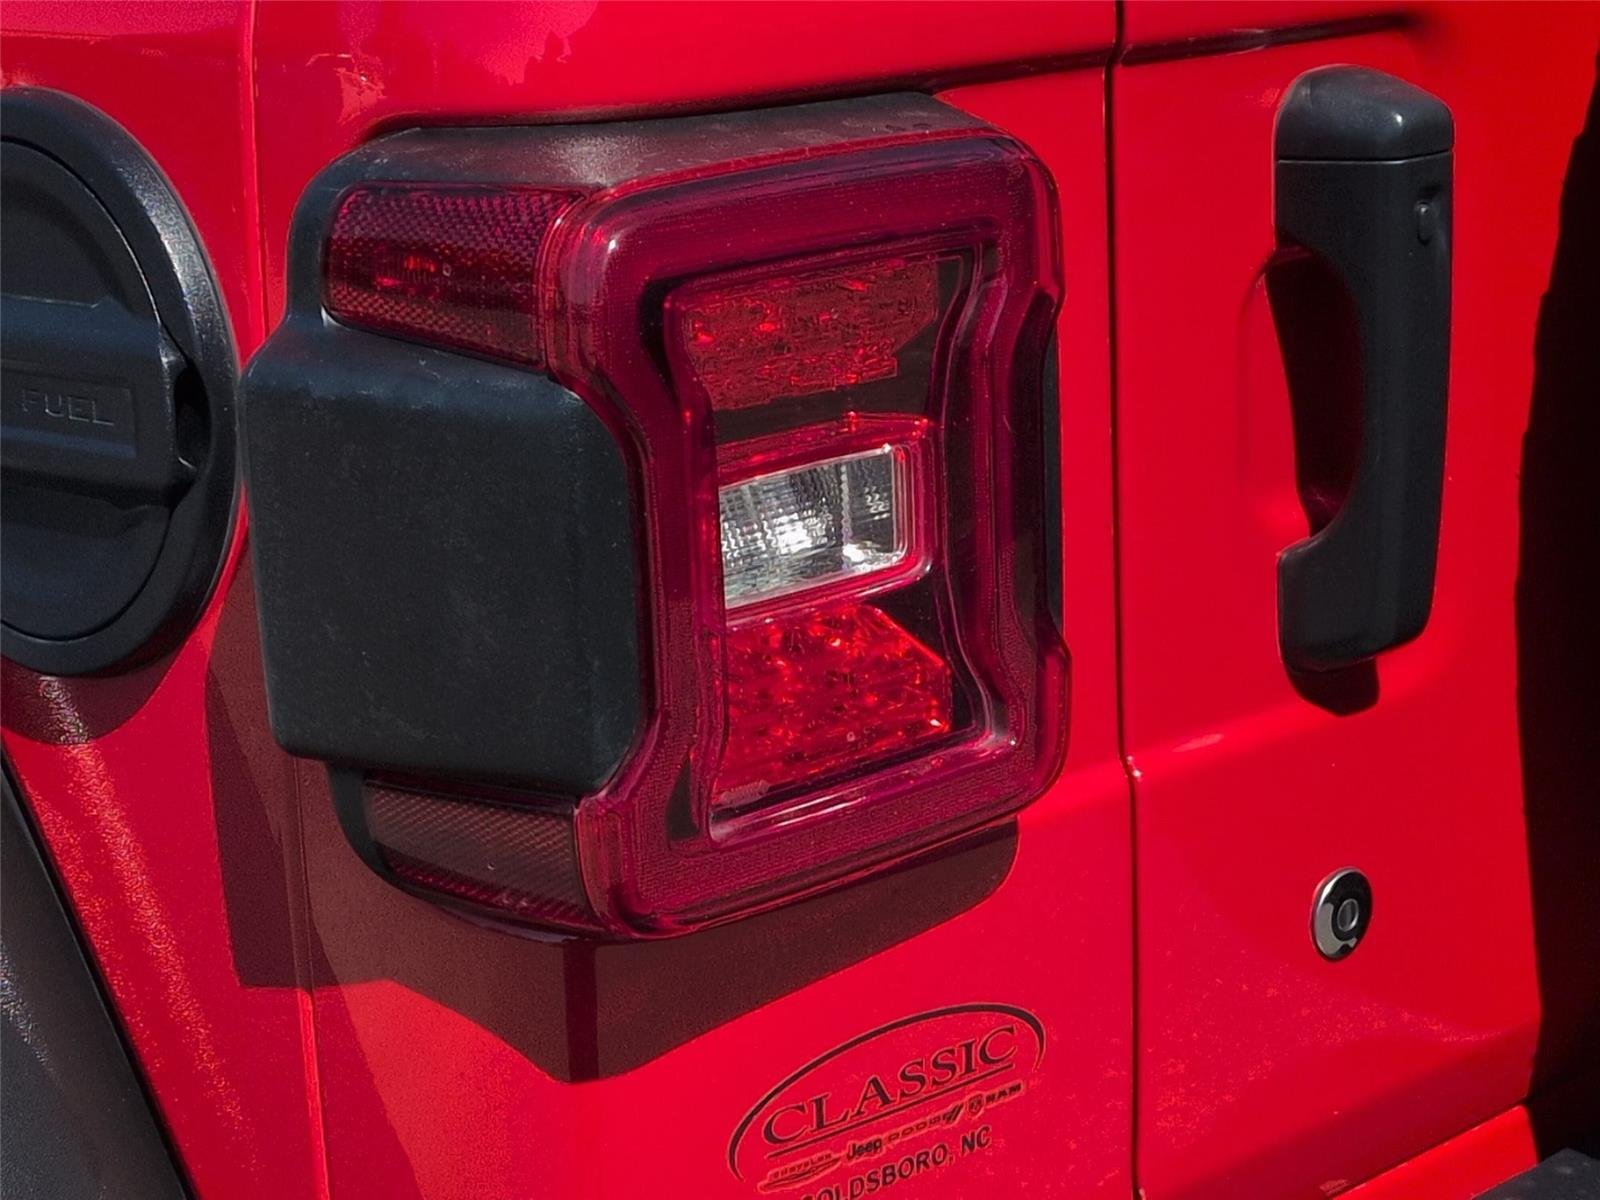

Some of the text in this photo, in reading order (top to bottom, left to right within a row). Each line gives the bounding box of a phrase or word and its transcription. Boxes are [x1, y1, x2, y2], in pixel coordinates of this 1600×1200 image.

[22, 388, 115, 427] FUEL
[762, 1025, 1018, 1146] CLASSIC
[845, 1137, 883, 1161] Jeep
[985, 1082, 1021, 1103] RAM
[802, 1125, 991, 1200] OLDSBORO, NC
